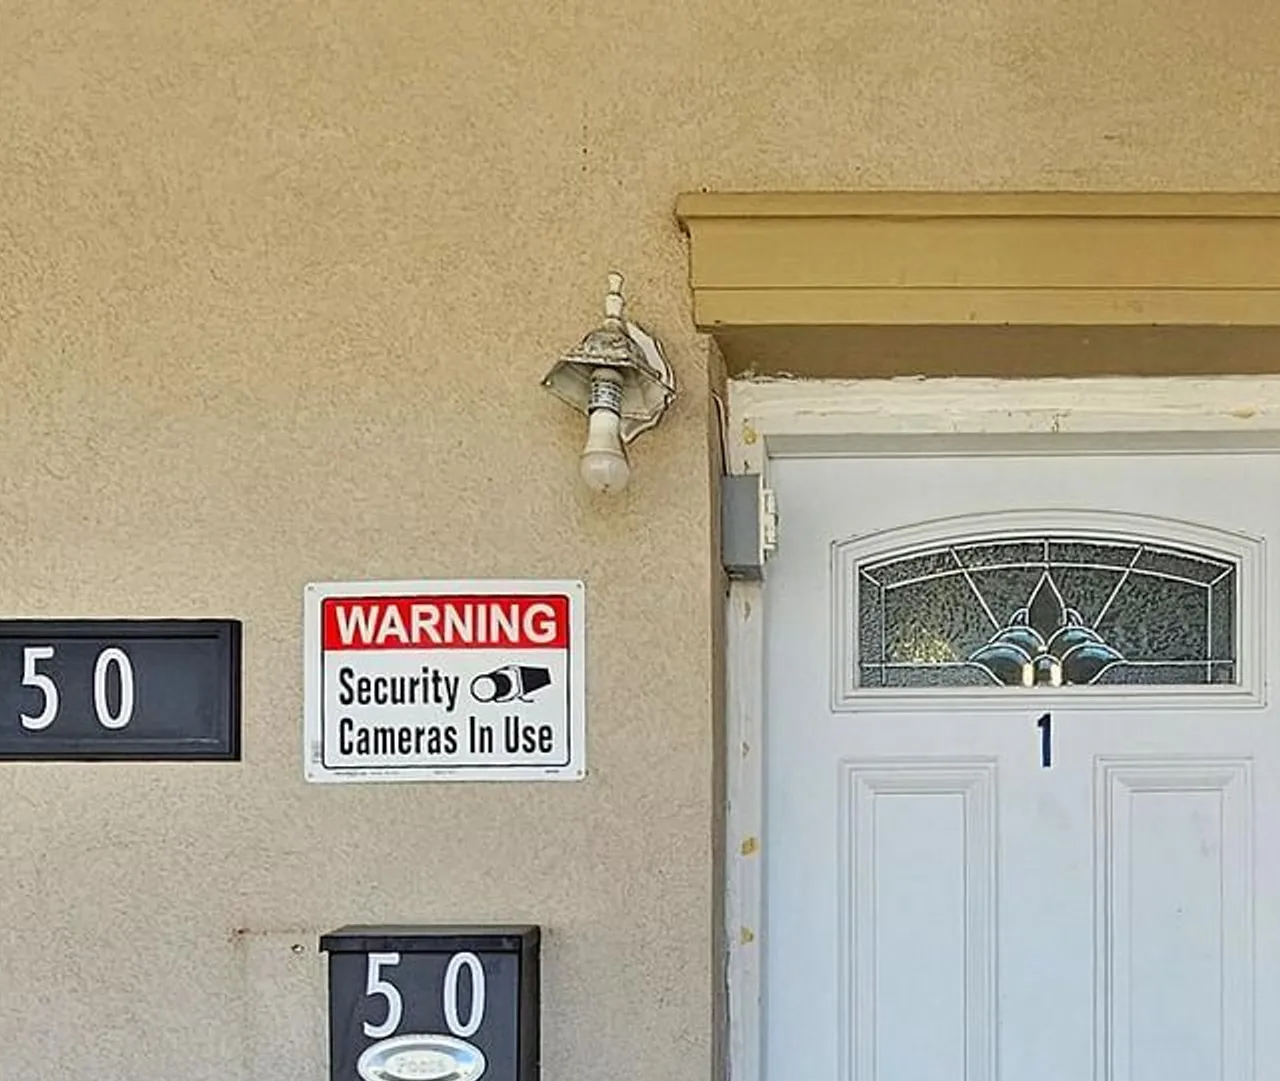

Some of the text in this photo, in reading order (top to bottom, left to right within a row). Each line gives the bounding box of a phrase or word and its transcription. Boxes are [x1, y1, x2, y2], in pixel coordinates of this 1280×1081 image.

[336, 604, 558, 645] WARNING
[20, 646, 134, 730] 50
[339, 666, 460, 712] Security
[339, 717, 458, 756] Cameras
[469, 716, 493, 753] In
[505, 716, 553, 753] Use
[1037, 712, 1052, 768] 1
[363, 952, 486, 1038] 50
